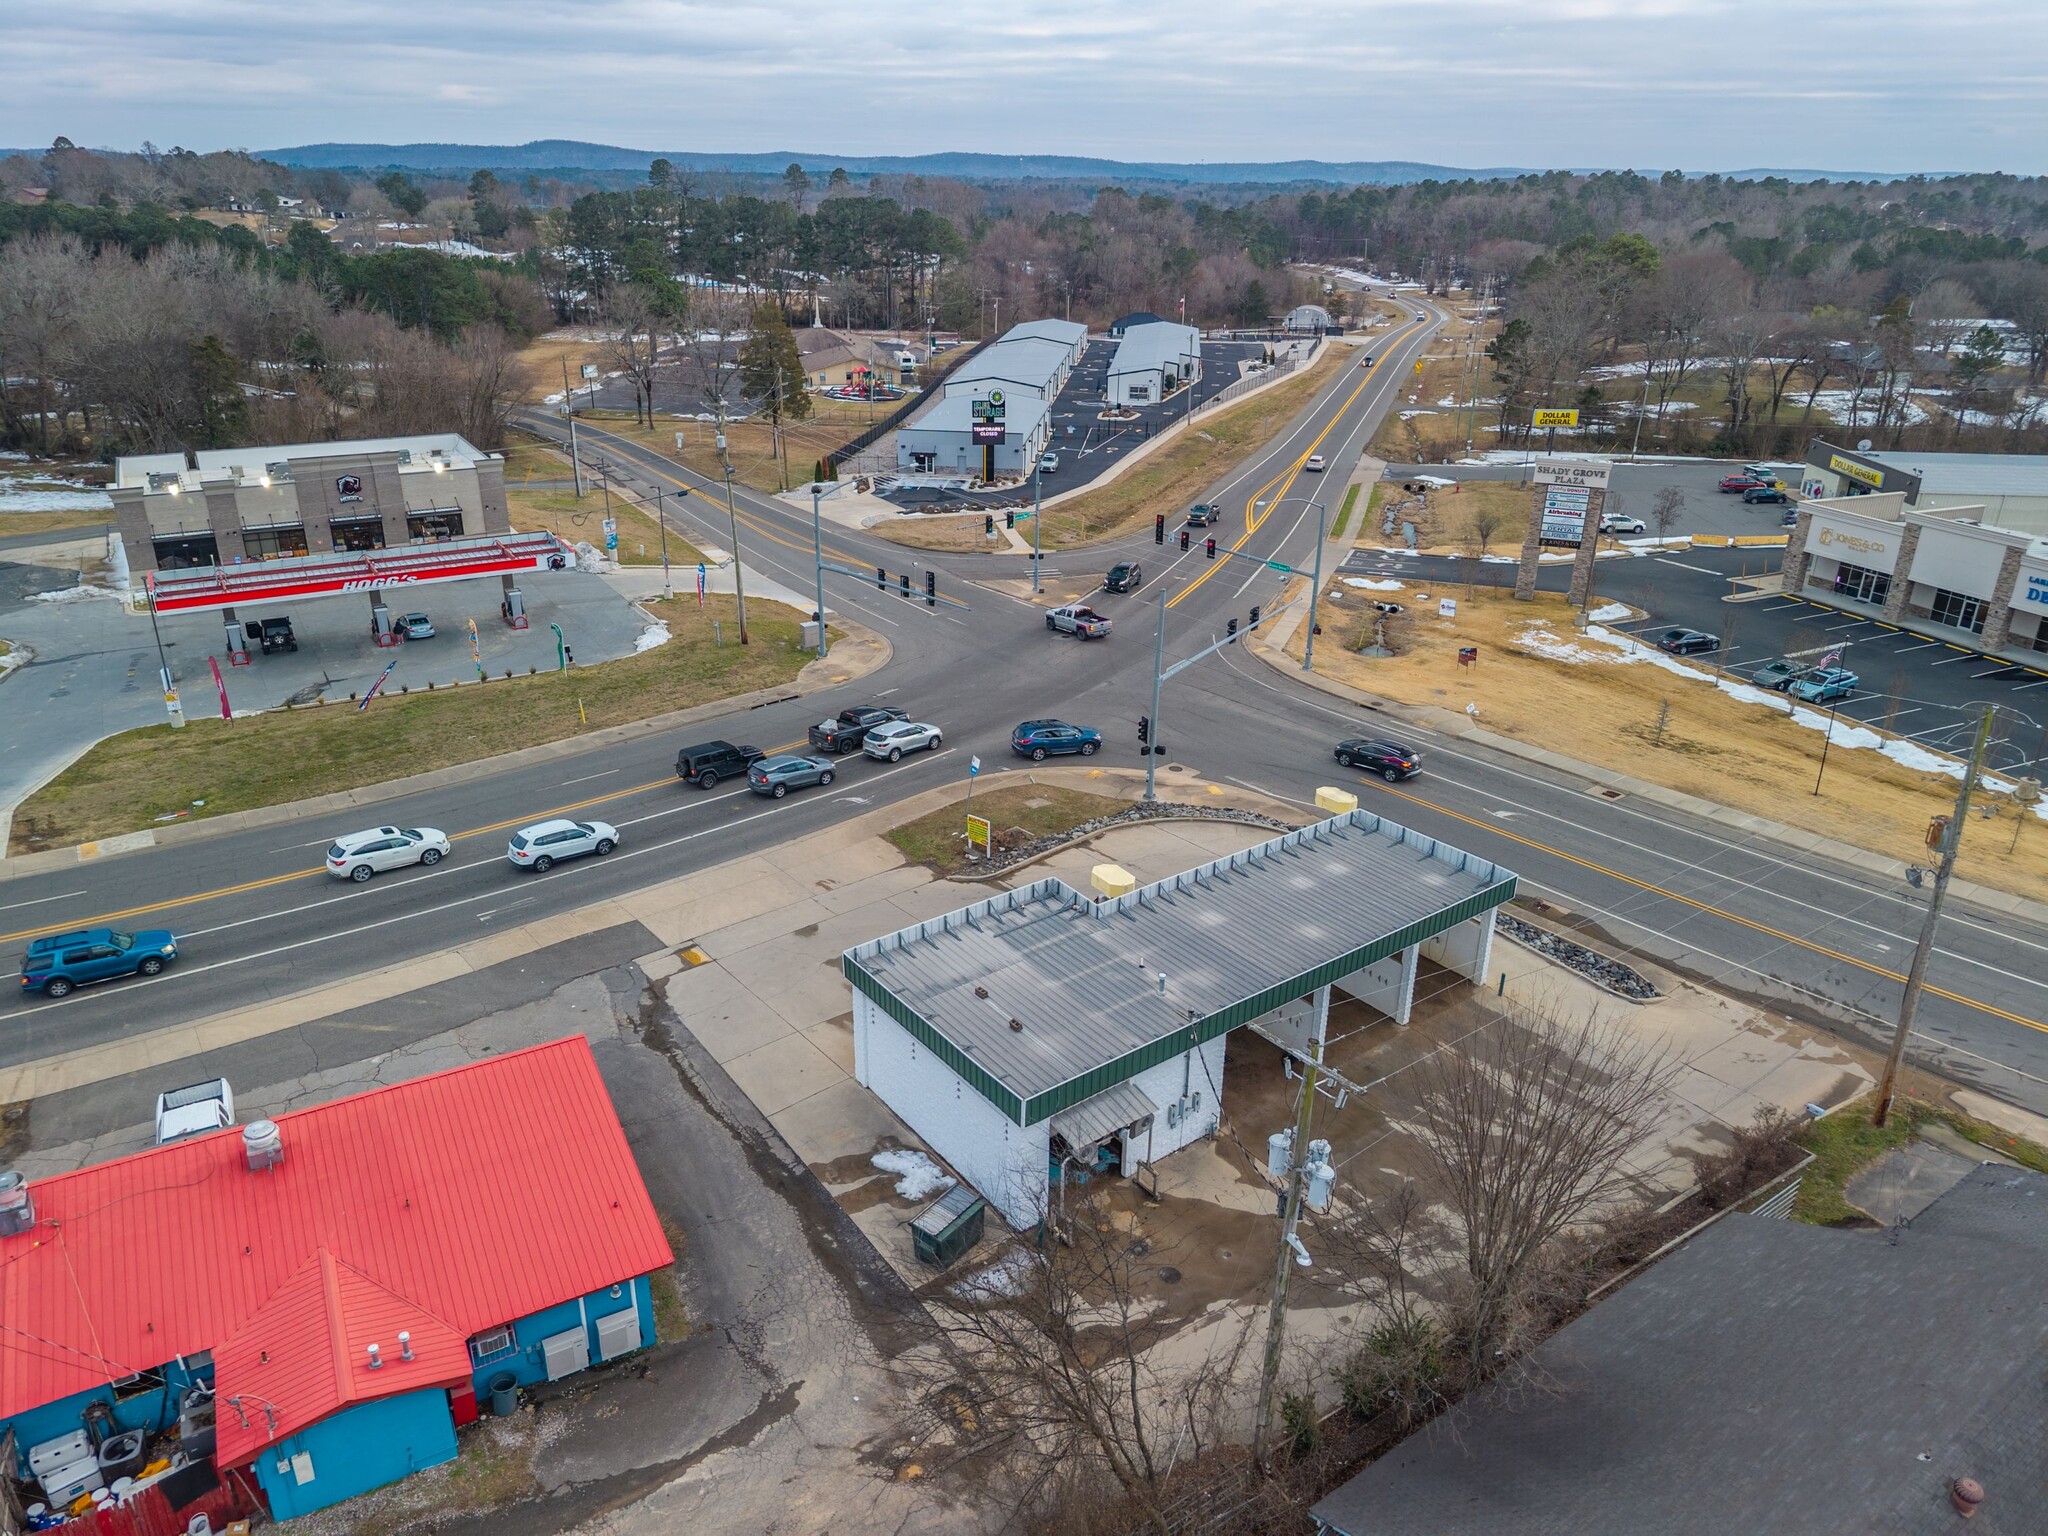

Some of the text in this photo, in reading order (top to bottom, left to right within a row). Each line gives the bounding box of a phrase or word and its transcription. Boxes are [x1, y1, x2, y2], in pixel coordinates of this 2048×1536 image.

[974, 408, 1004, 416] STORAGE
[1537, 466, 1606, 478] SHADY GROVE
[1834, 460, 1877, 482] DOLLAR GENERAL
[1554, 476, 1585, 485] PLAZA
[342, 574, 418, 593] HOGG's
